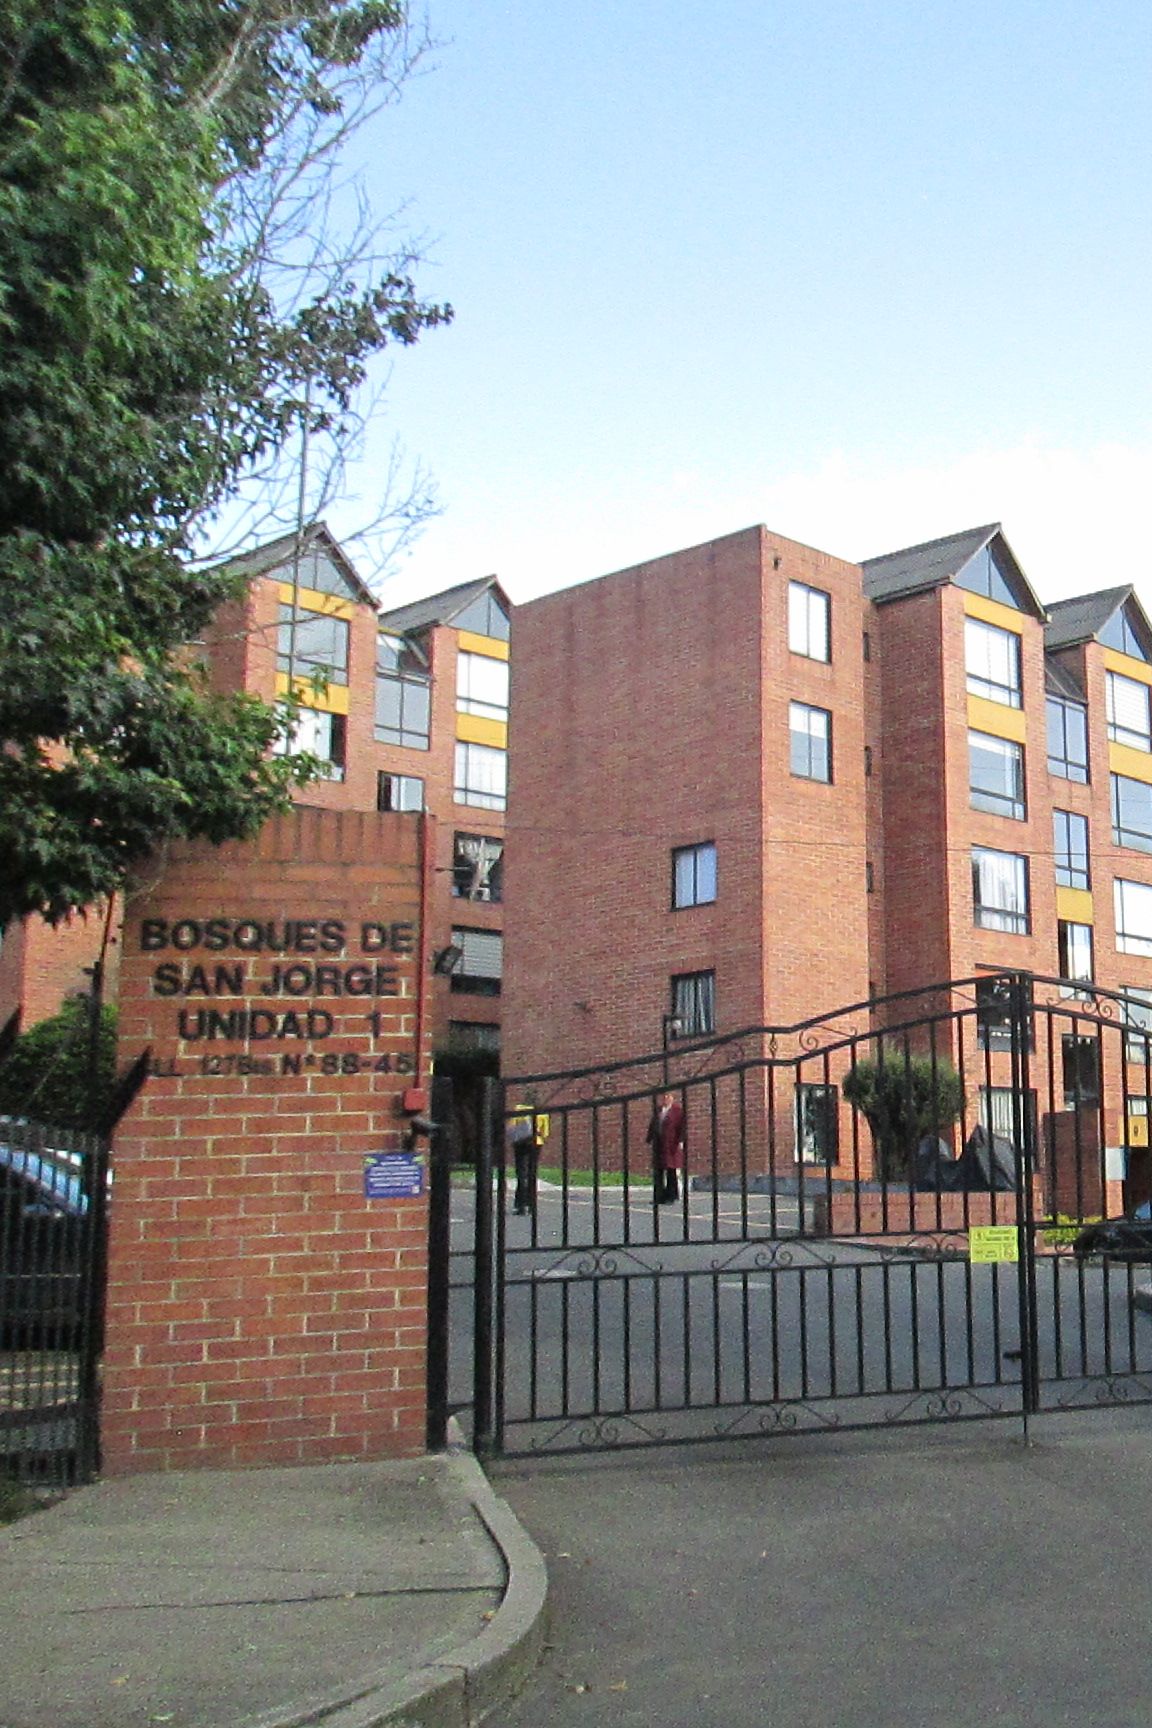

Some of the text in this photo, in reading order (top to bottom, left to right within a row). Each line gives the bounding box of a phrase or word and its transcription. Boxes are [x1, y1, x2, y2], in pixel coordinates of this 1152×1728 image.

[141, 919, 416, 952] BOSQUES DE
[153, 963, 399, 996] SAN JORGE
[177, 1009, 382, 1040] UNIDAD 1
